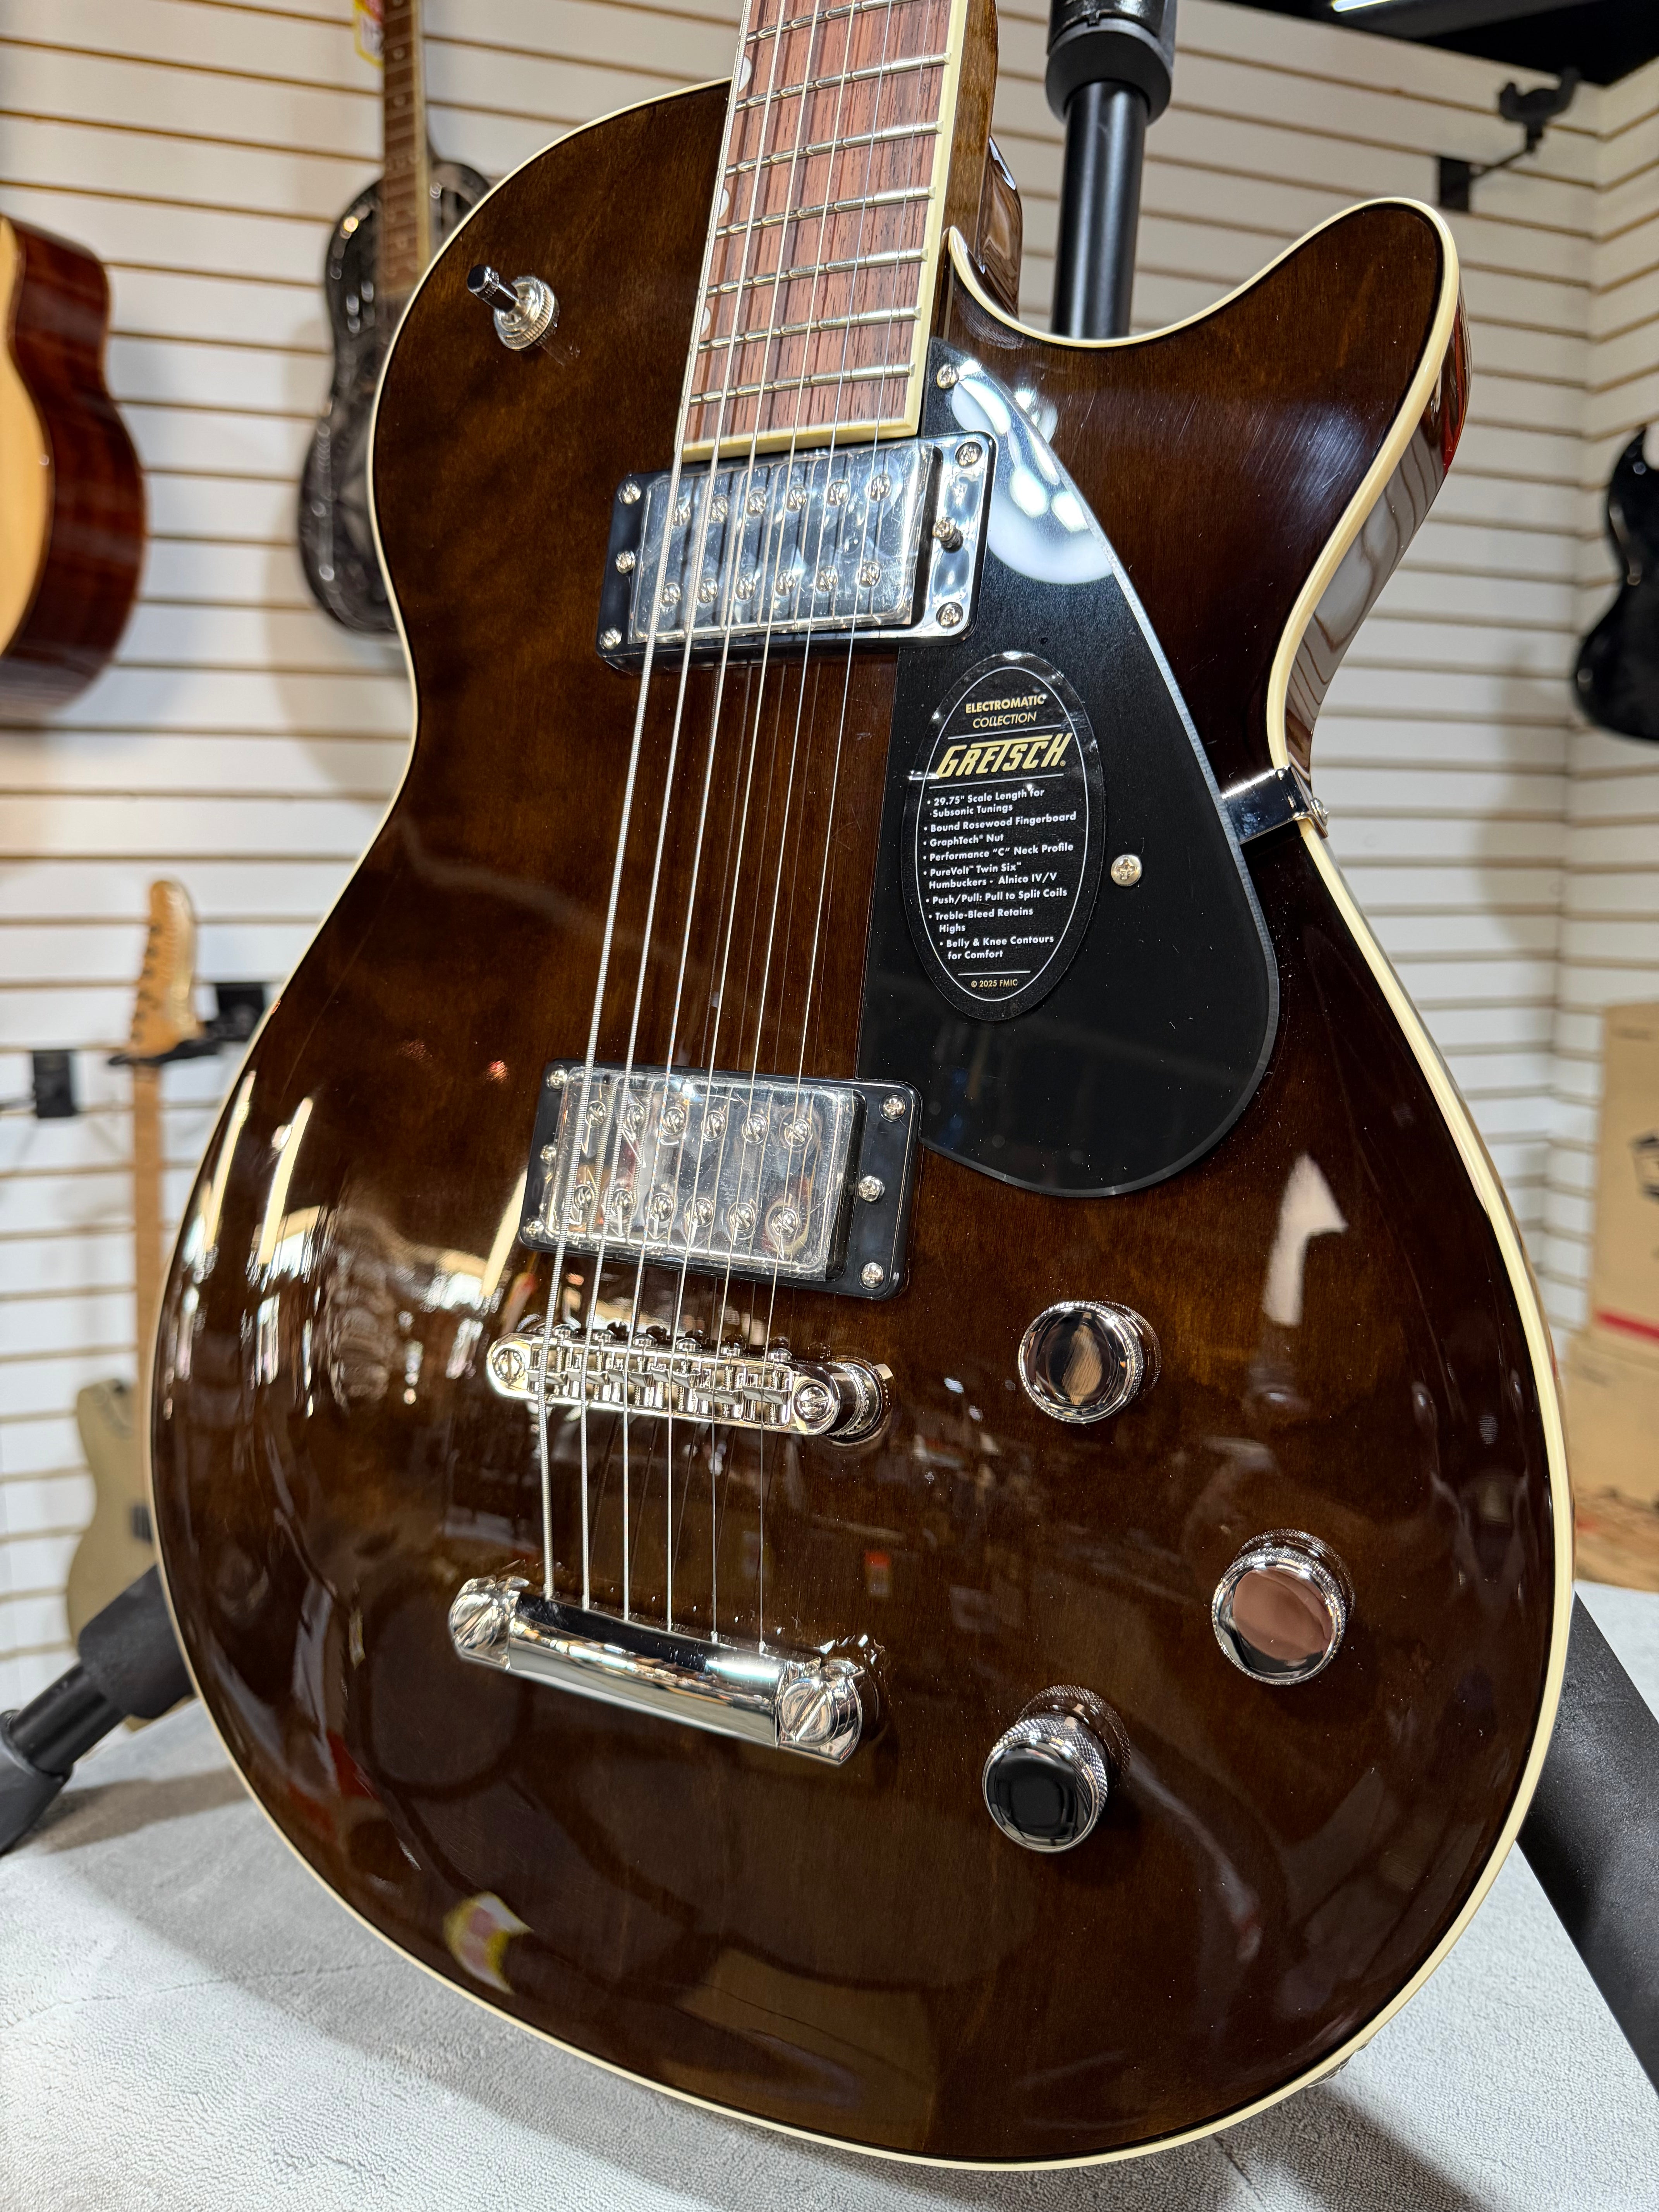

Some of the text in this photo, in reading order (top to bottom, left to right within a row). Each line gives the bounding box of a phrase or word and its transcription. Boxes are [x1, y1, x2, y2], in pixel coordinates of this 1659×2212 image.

[966, 695, 1045, 713] ELECTROMATIC
[973, 711, 1037, 728] COLLECTION
[968, 793, 992, 803] Scale
[995, 789, 1027, 801] Length
[1030, 788, 1044, 798] for
[933, 804, 1013, 817] Subsonic Tunings
[931, 811, 1076, 832] Bound Rosewood Fingerboard
[986, 834, 1004, 842] Nut
[930, 851, 989, 861] Performance
[1014, 845, 1038, 855] Neck
[1042, 842, 1073, 853] Profile
[976, 864, 998, 873] Twin
[929, 878, 986, 889] Humbuckers
[998, 875, 1029, 884] Alnico
[1032, 872, 1057, 883] IV/V
[933, 893, 982, 905] Push/Pull:
[985, 891, 1003, 901] Pull
[1018, 889, 1040, 901] Split
[1043, 887, 1067, 897] Coils
[935, 907, 1033, 920] Treble-Bleed Retains
[939, 923, 965, 934] Highs
[946, 938, 970, 948] Belly
[973, 938, 979, 946] &
[1010, 936, 1054, 944] Contours
[948, 950, 1003, 960] for Comfort
